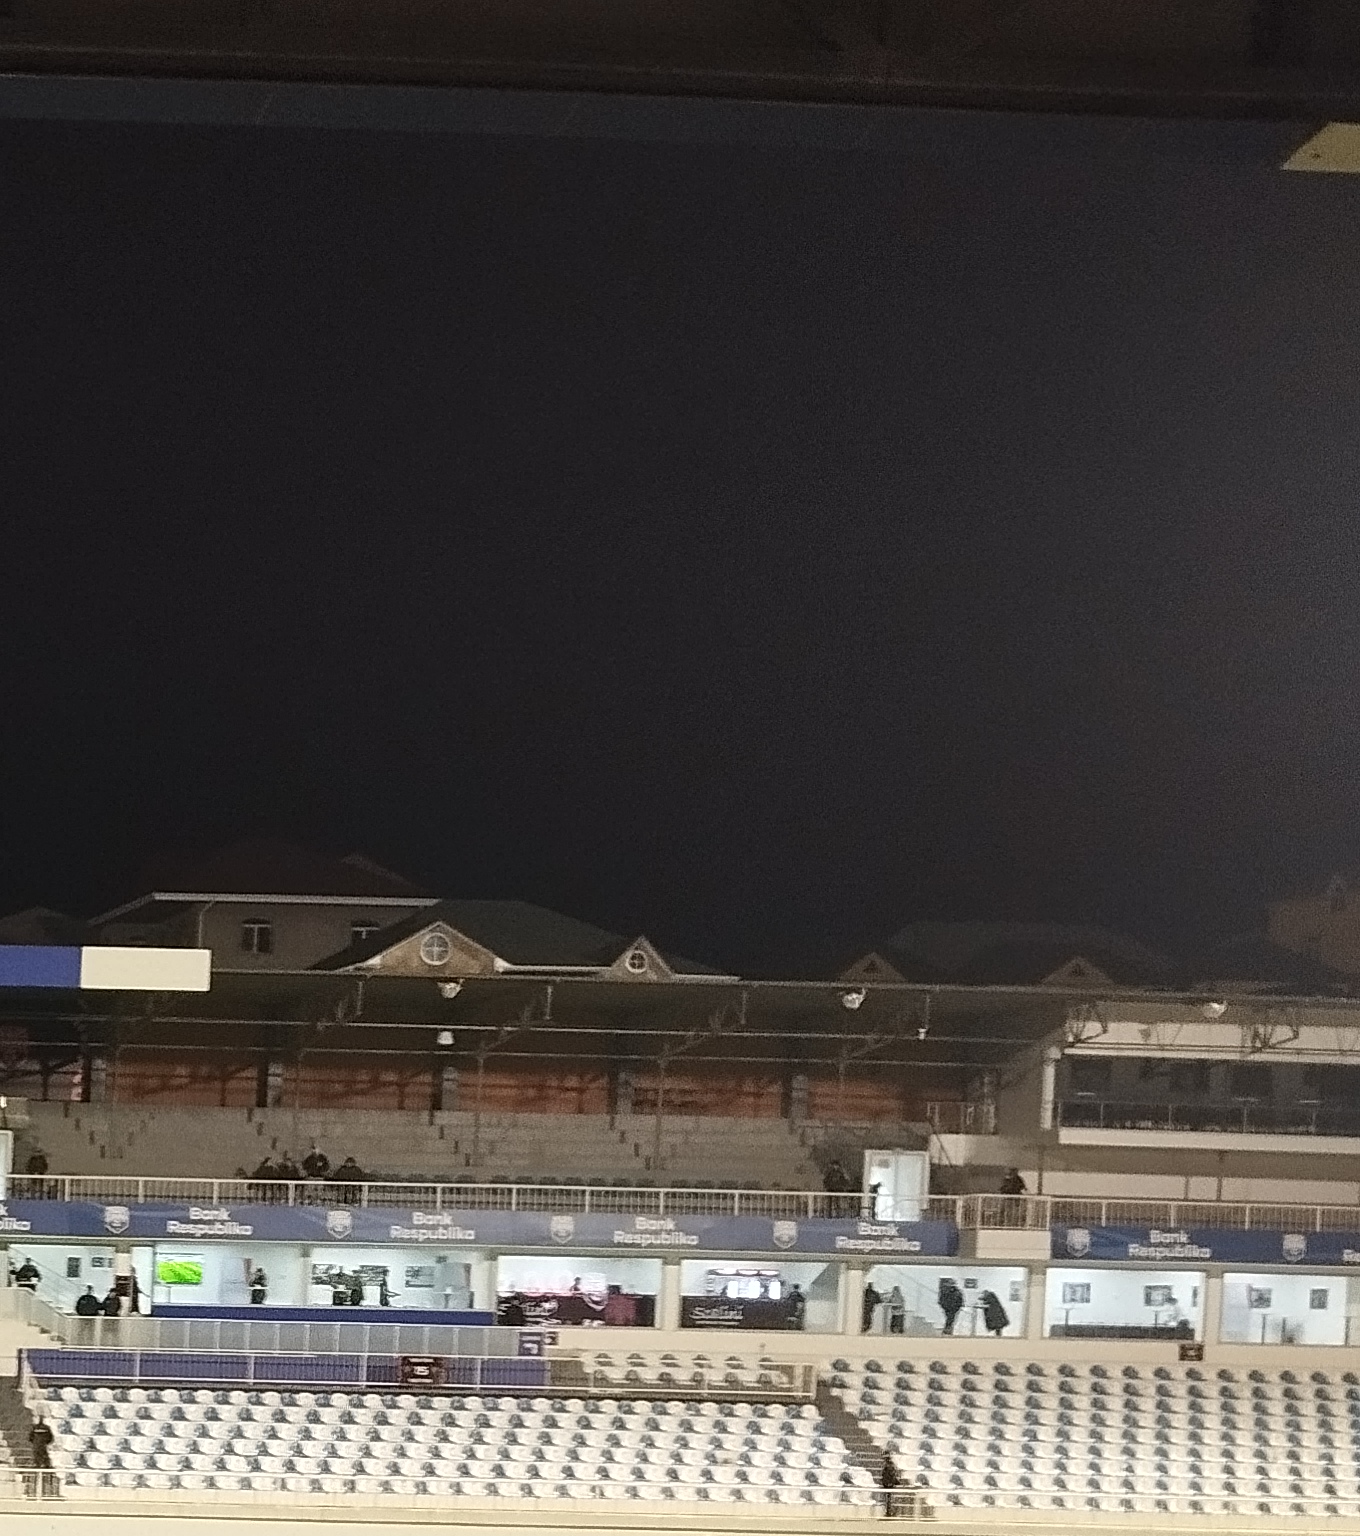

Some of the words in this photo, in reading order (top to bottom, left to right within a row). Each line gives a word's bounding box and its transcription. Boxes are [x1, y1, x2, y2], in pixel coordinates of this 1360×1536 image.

[189, 1207, 231, 1220] Bank
[412, 1212, 454, 1225] Bank
[166, 1219, 254, 1236] Respublika
[635, 1217, 675, 1231] Bank
[857, 1222, 899, 1236] Bank
[389, 1224, 476, 1241] Respublika
[612, 1229, 700, 1246] Respublika
[1150, 1229, 1187, 1244] Bank
[835, 1234, 922, 1251] Respublika
[1128, 1243, 1211, 1260] Respublika
